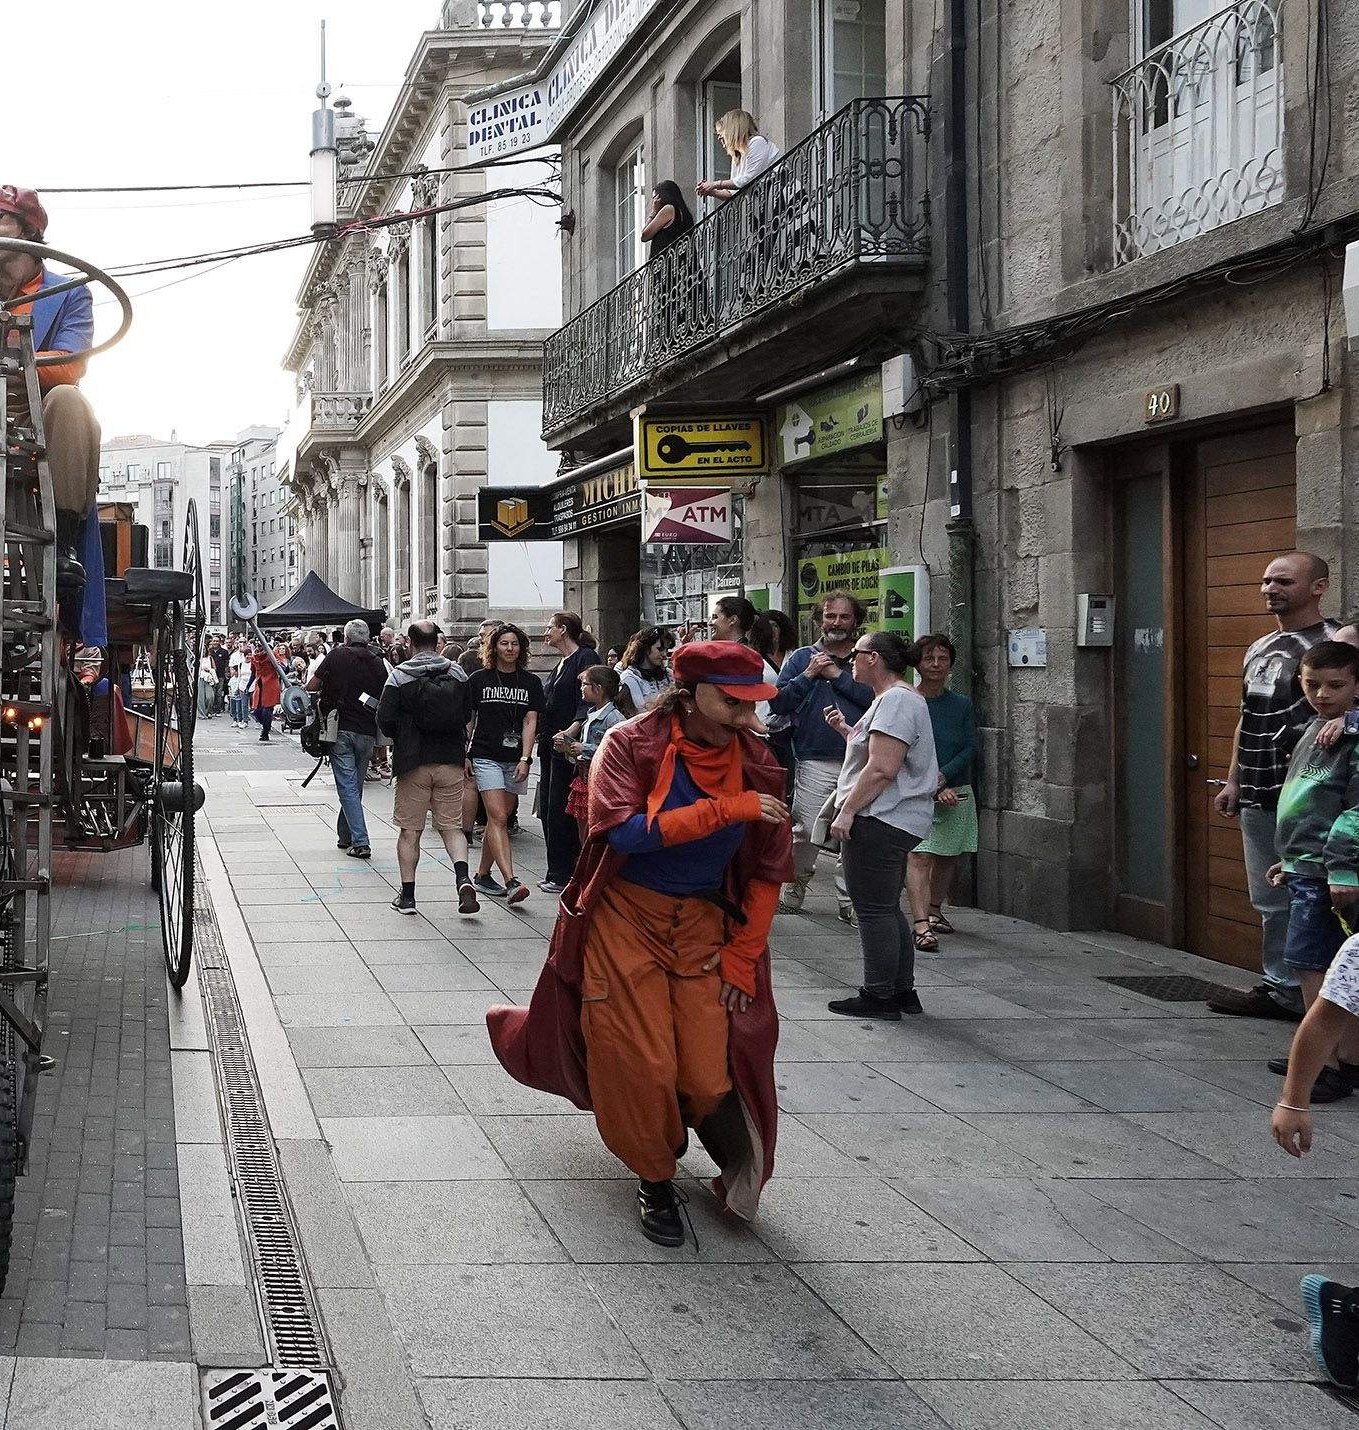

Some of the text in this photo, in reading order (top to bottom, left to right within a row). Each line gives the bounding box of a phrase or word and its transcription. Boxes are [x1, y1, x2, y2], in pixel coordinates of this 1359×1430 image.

[470, 90, 542, 126] CLINICA
[469, 111, 542, 146] DENTAL
[497, 139, 507, 152] 85
[510, 136, 518, 147] 19
[521, 132, 531, 144] 23
[1148, 391, 1170, 416] 40
[655, 423, 751, 434] COPIAS DE LLAVES
[697, 455, 753, 465] EN EL ACTO
[581, 504, 619, 525] GESTION
[682, 506, 727, 522] ATM
[827, 558, 880, 576] CAMBIO DE PILAS
[851, 577, 860, 590] DE
[861, 575, 880, 589] COCH
